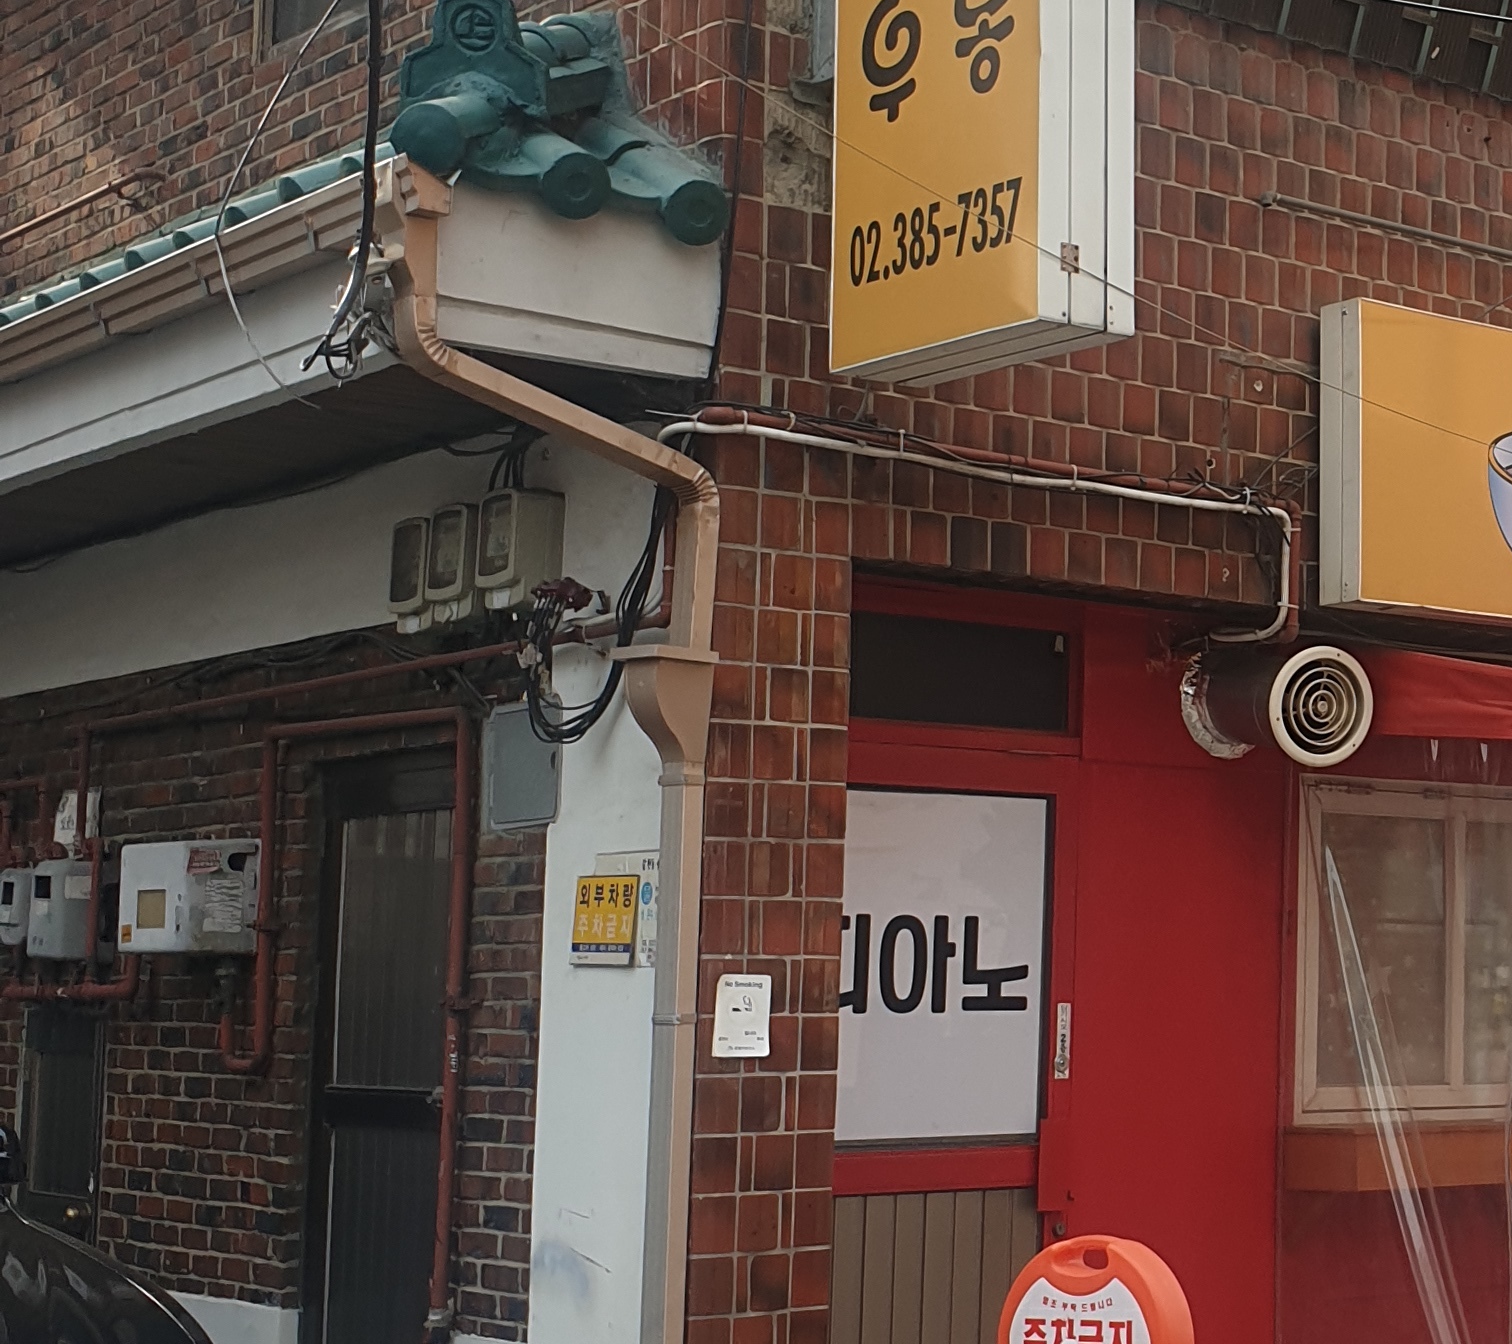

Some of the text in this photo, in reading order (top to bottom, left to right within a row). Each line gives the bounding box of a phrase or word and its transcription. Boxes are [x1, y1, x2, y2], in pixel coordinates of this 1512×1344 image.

[850, 176, 1023, 288] 02.385-7357
[579, 883, 634, 908] 외부차량
[577, 913, 631, 939] 주차금지
